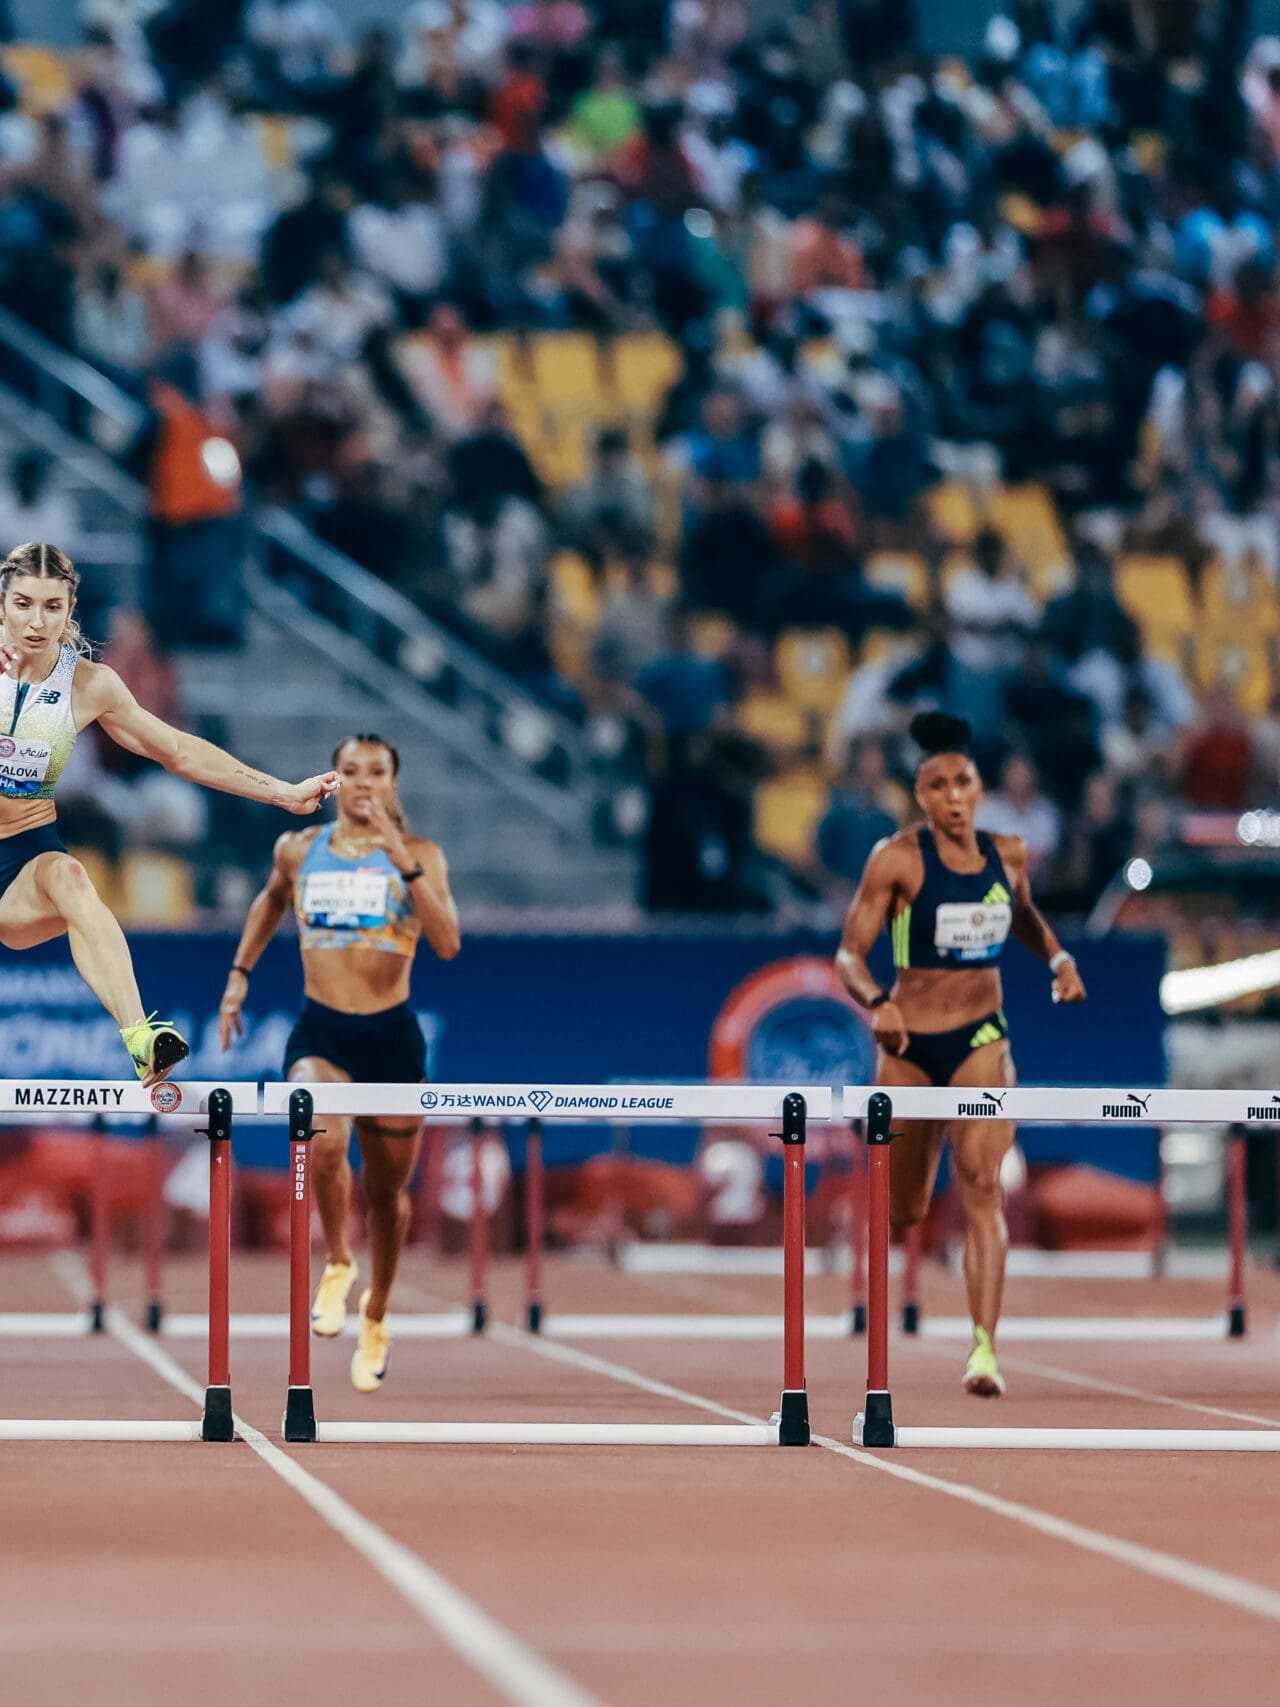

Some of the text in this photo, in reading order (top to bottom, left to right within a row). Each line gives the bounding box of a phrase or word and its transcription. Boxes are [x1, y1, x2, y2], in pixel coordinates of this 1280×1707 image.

[15, 1088, 124, 1105] MAZZRATY
[473, 1095, 527, 1107] WANDA
[554, 1096, 619, 1108] DIAMOND
[621, 1097, 674, 1109] LEAGUE
[958, 1103, 997, 1116] PUMA
[1102, 1105, 1141, 1118] PUMA
[1247, 1107, 1280, 1120] PUM
